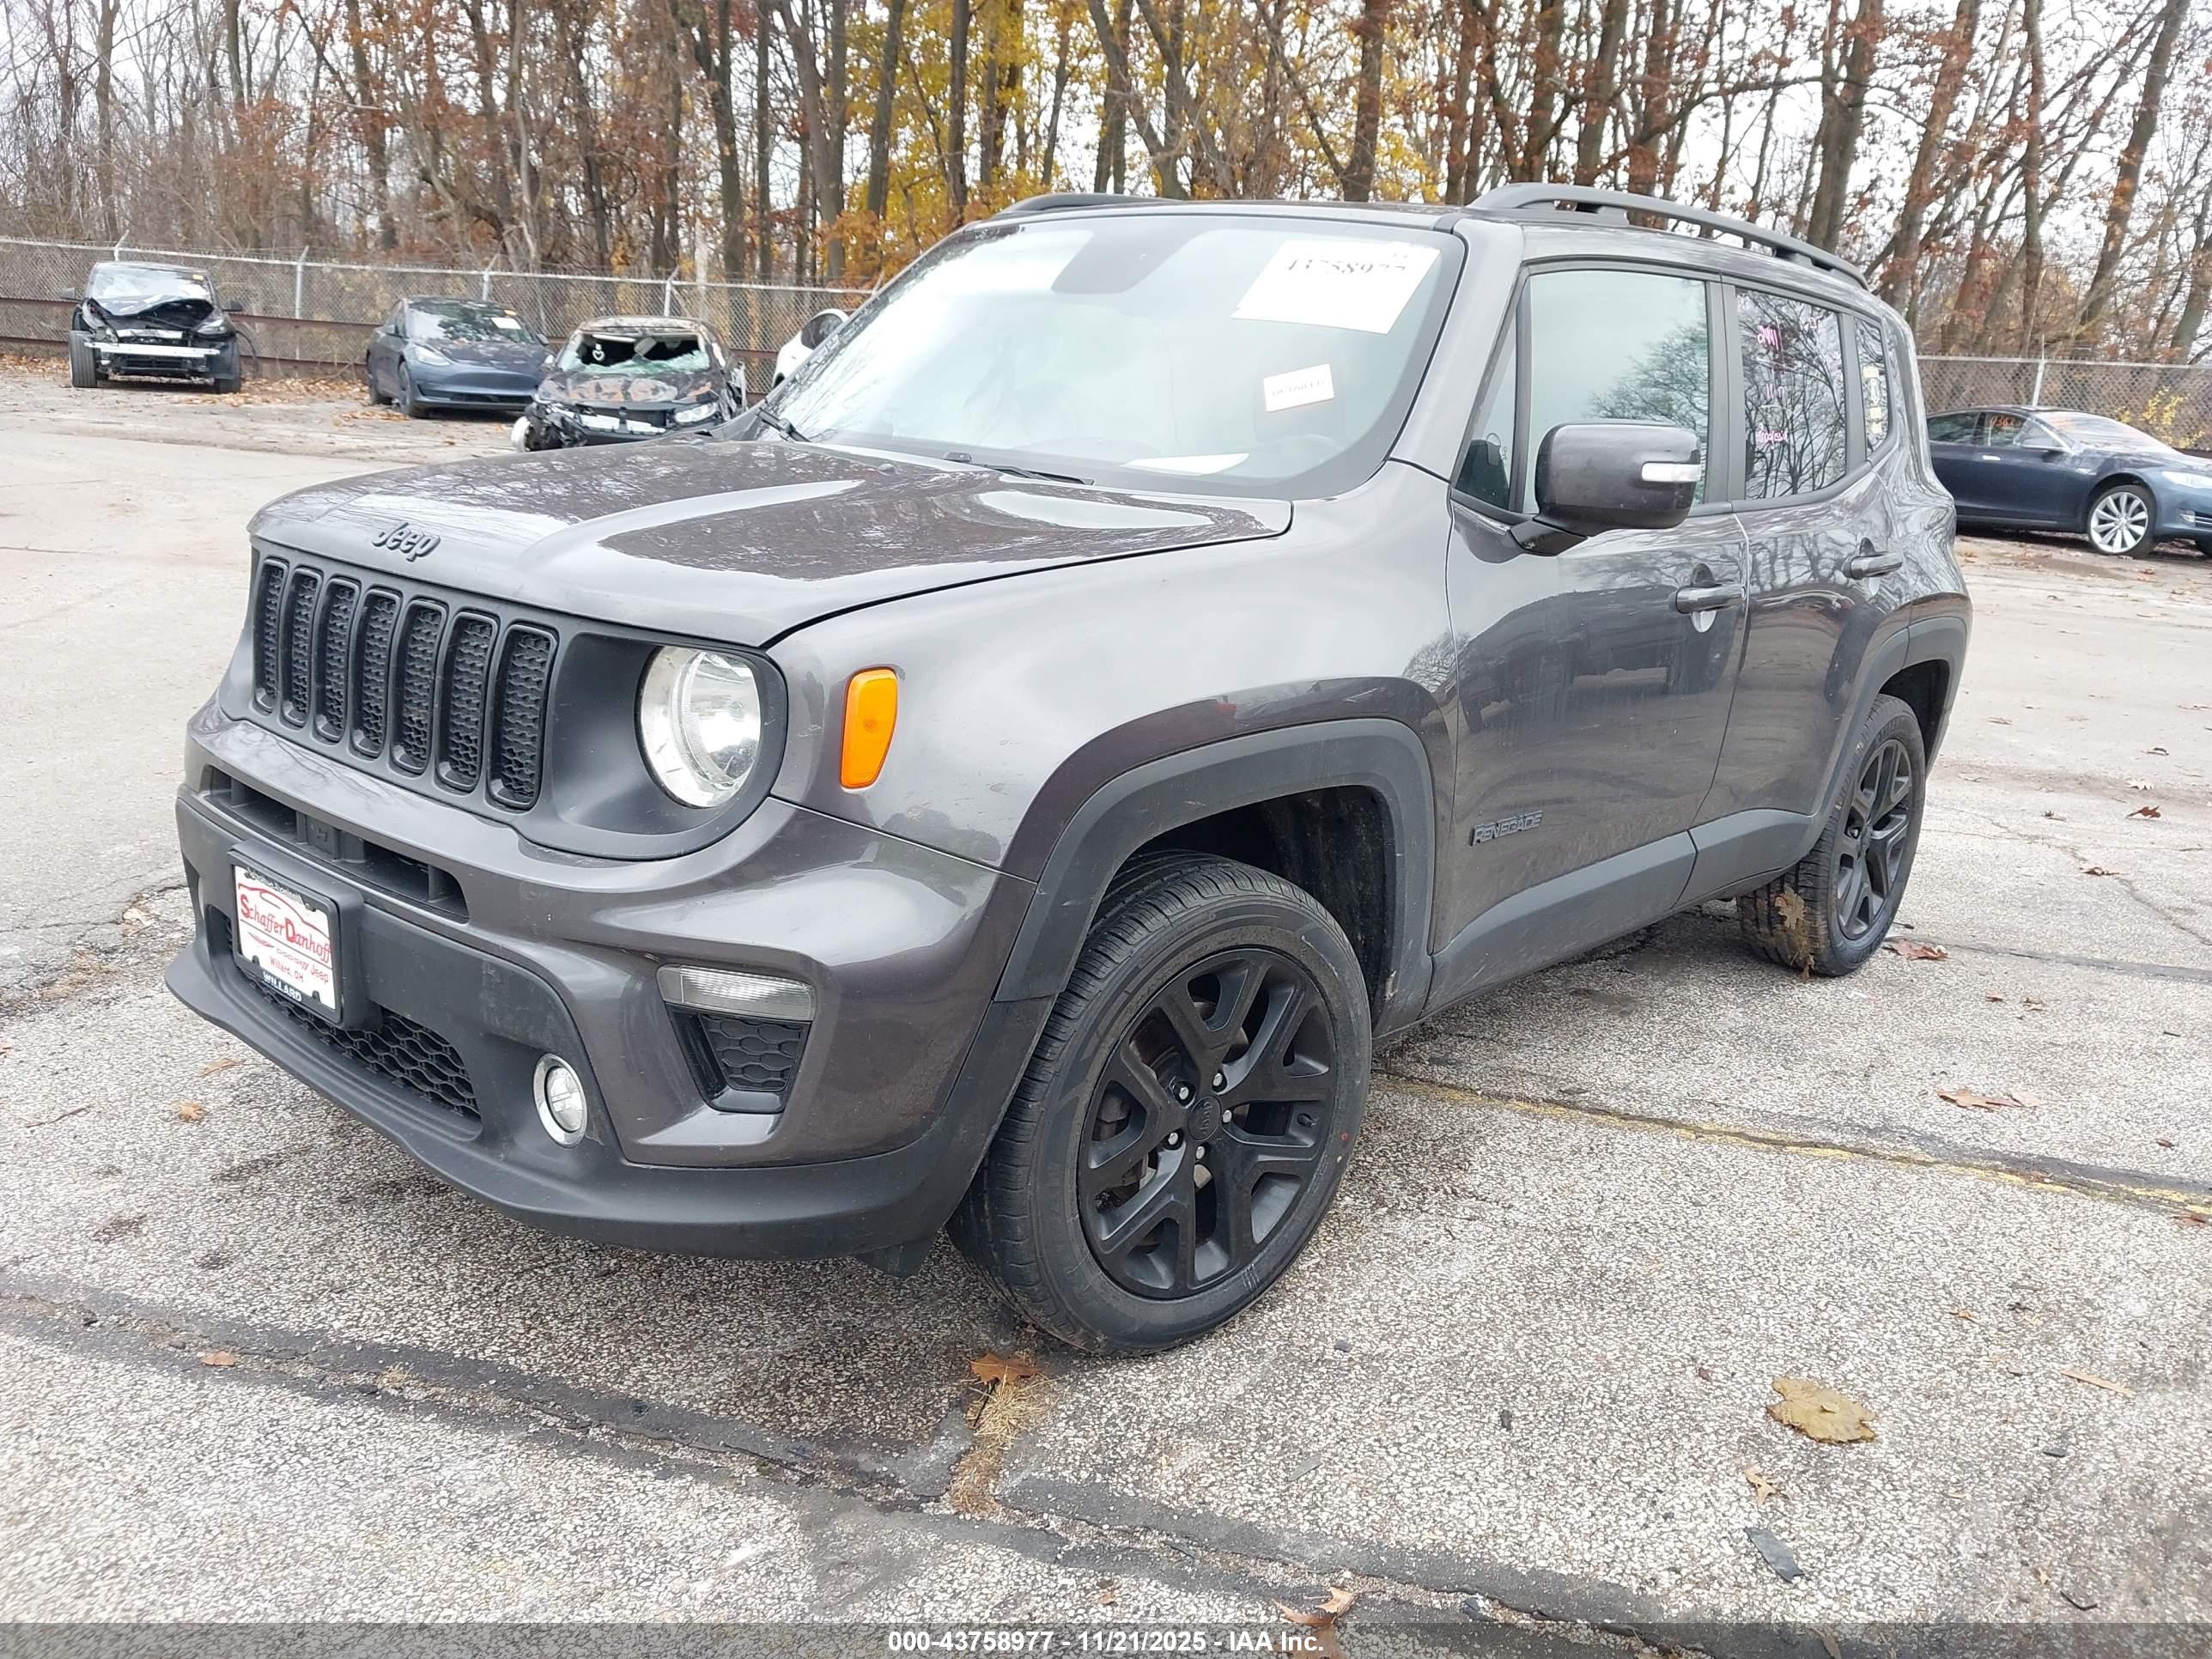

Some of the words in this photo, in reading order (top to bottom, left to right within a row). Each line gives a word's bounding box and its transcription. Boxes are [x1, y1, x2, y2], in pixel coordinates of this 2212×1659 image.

[371, 521, 441, 562] Jeep
[1468, 809, 1543, 847] RENEGADE
[263, 971, 303, 1002] WILLARD
